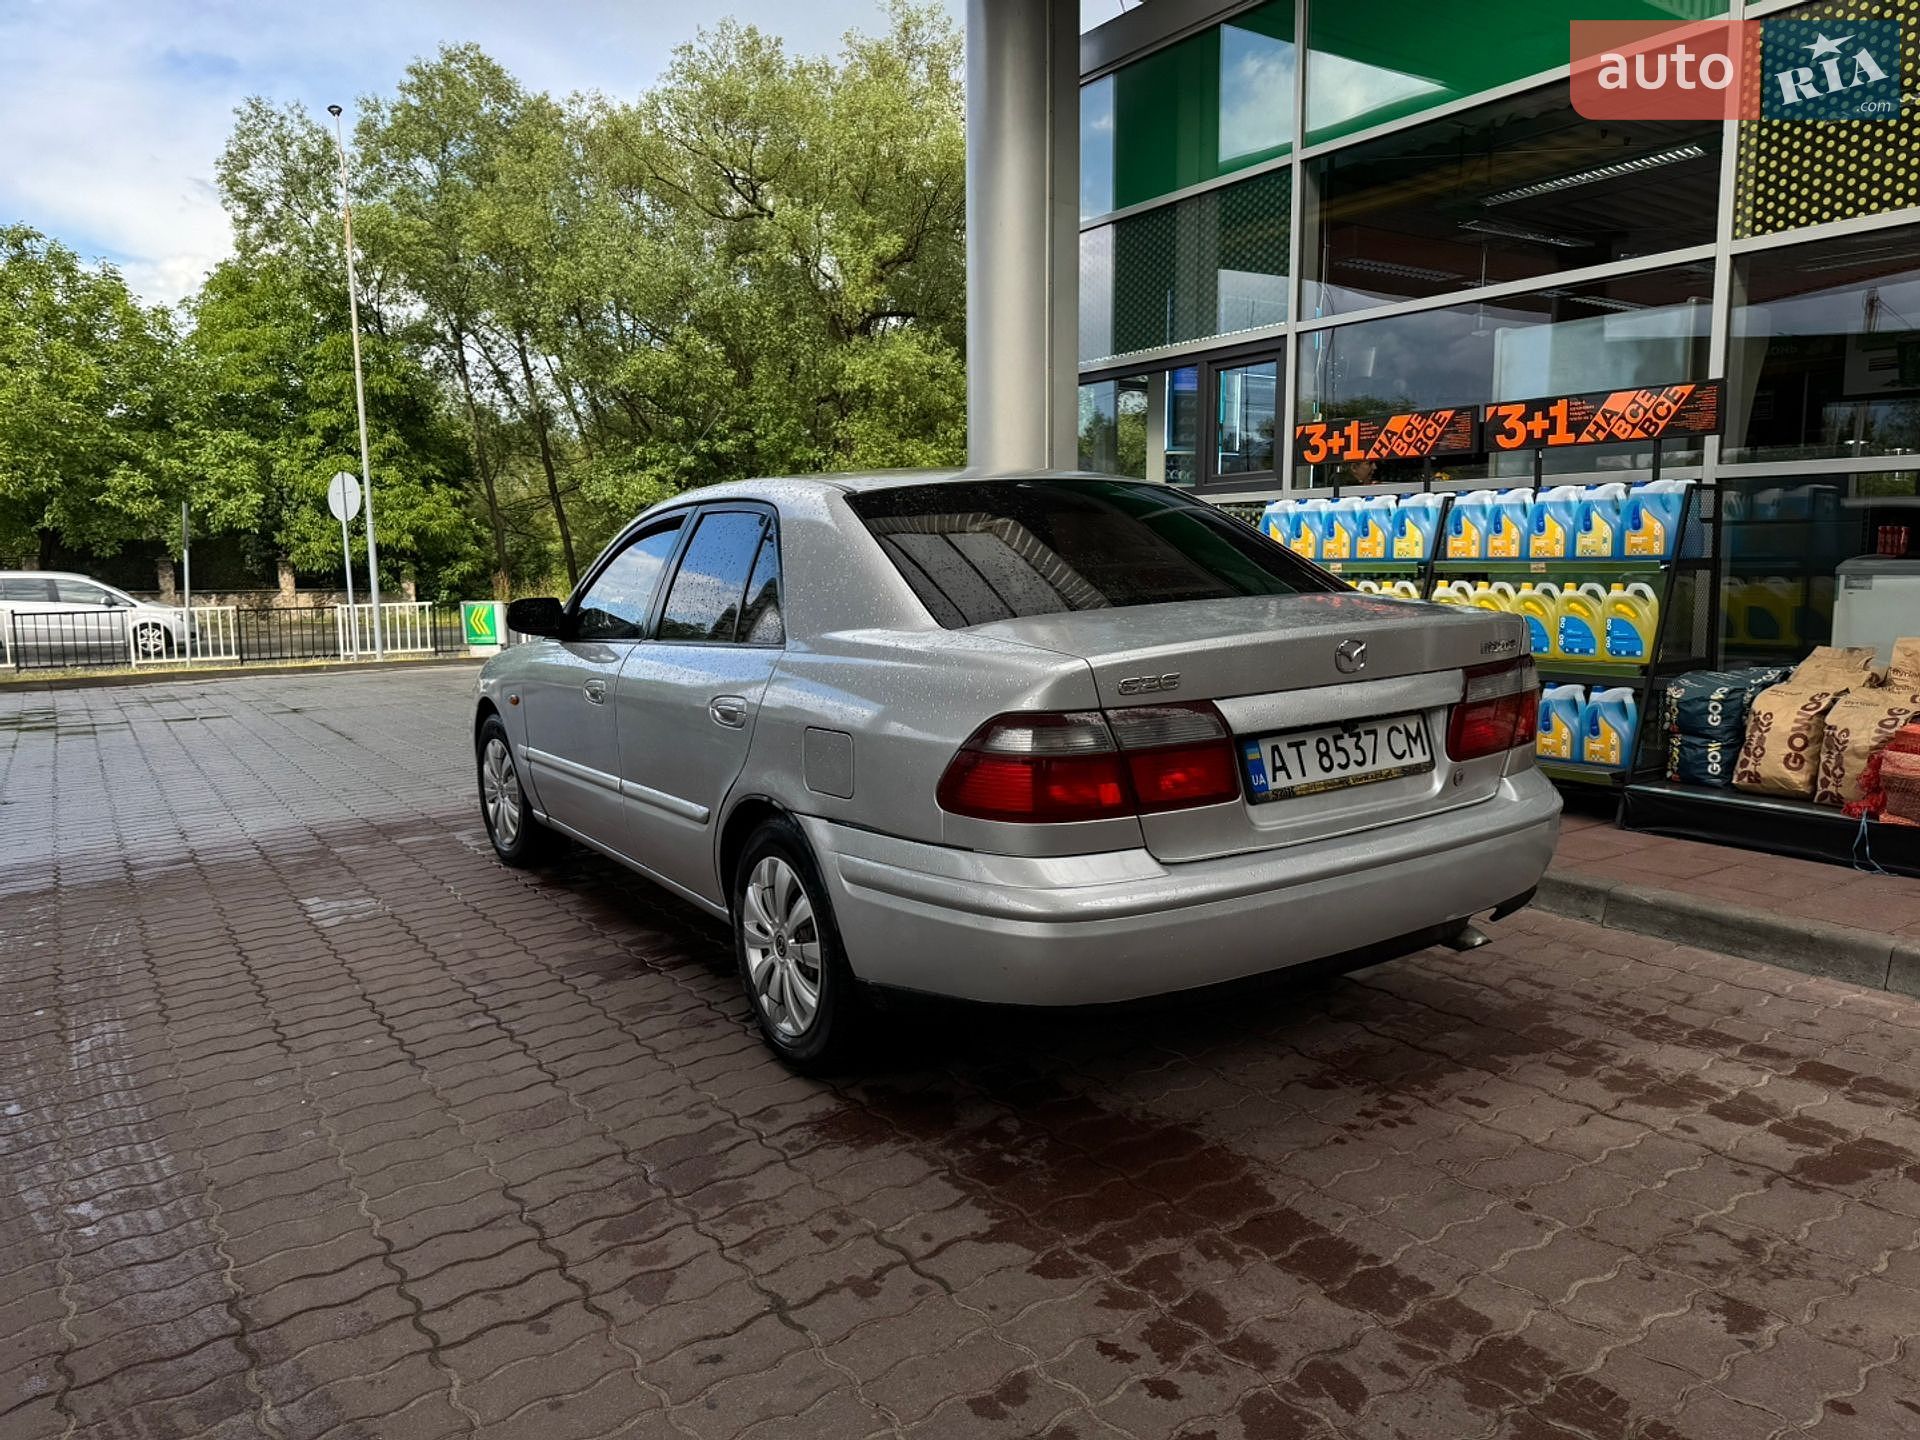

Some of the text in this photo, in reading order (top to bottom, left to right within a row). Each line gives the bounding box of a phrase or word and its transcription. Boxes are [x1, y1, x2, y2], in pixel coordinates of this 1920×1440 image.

[1303, 419, 1366, 464] 3+1
[1495, 398, 1576, 449] 3+1
[1270, 720, 1428, 783] AT 8537 CM
[1252, 773, 1267, 787] UA
